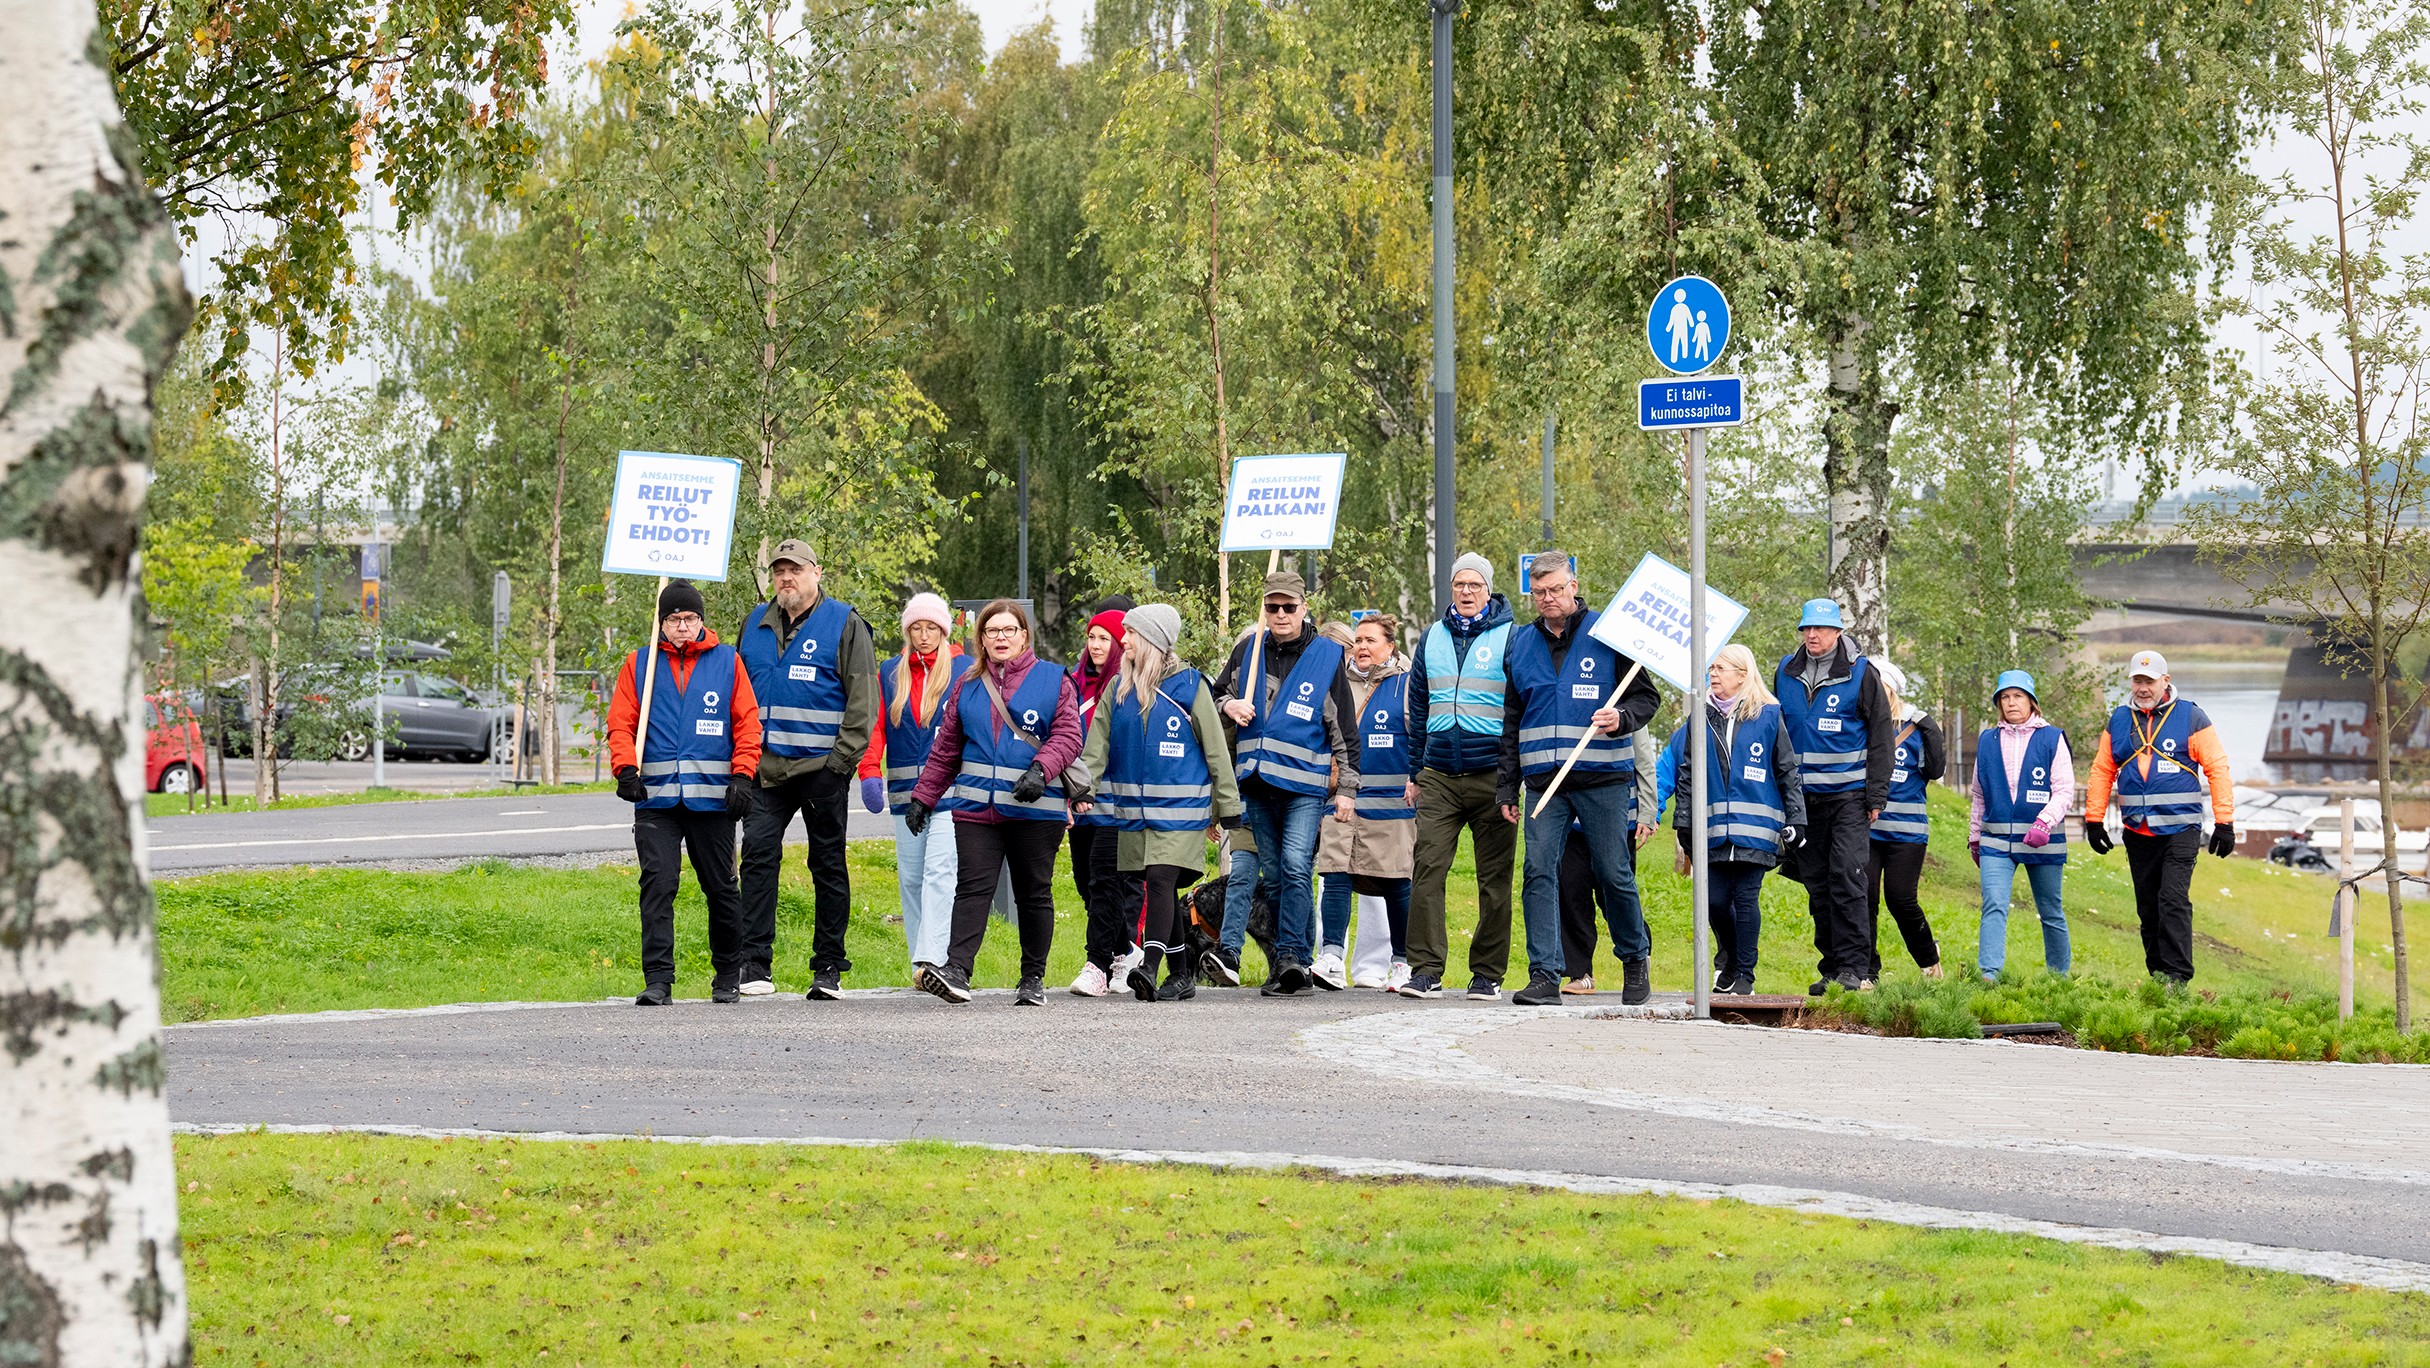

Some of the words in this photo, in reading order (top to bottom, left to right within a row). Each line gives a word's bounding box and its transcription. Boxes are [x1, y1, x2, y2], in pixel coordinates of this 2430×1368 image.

[1666, 388, 1677, 402] Ei
[1650, 404, 1731, 420] kunnossapitoa
[640, 470, 715, 485] ANSAITSEMME
[1250, 475, 1322, 484] ANSAITSEMME
[637, 484, 713, 505] REILUT
[1247, 486, 1320, 501] REILUN
[646, 502, 698, 523] TYÖ-
[1236, 502, 1326, 517] PALKAN!
[628, 523, 710, 546] EHDOT!
[664, 553, 685, 563] OAJ
[1638, 590, 1710, 635] REILU
[1621, 600, 1707, 649] PALKA
[1646, 646, 1665, 661] OAJ
[1474, 663, 1489, 671] OAJ
